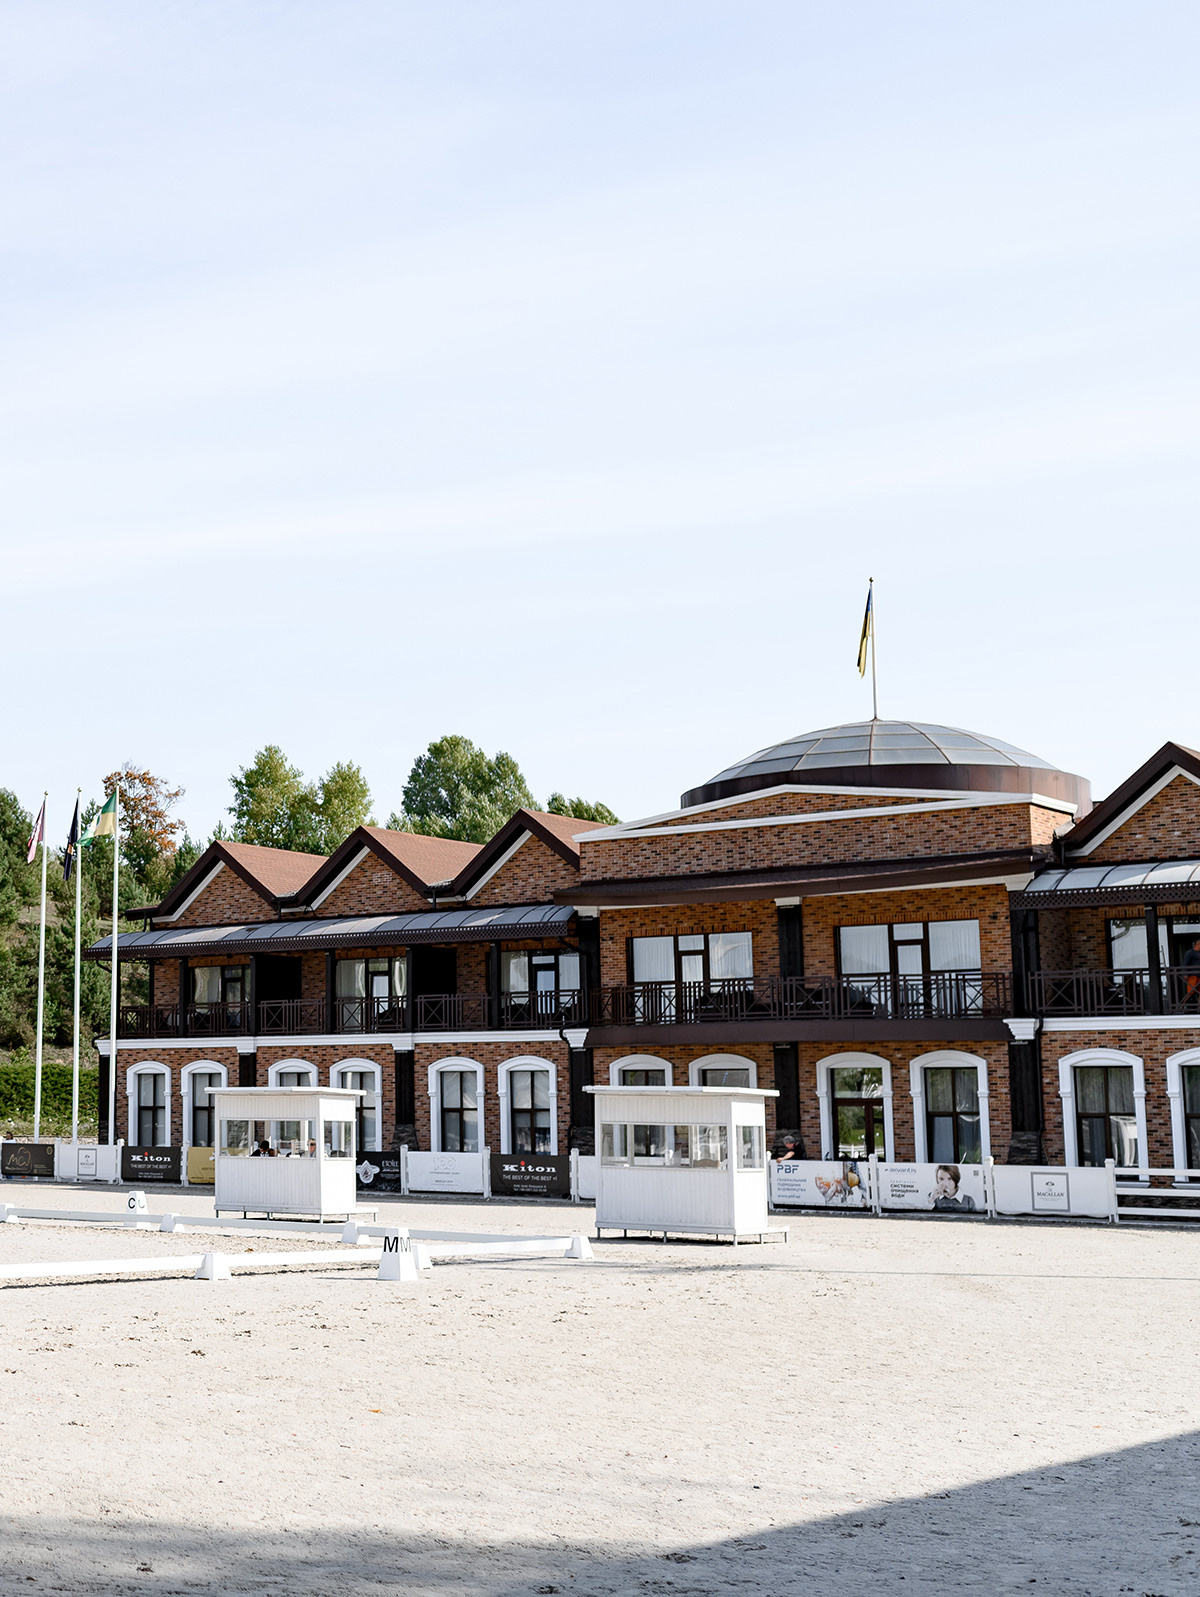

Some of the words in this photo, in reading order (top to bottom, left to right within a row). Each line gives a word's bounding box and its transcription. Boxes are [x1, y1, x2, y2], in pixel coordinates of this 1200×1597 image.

[131, 1151, 172, 1162] Kiton
[502, 1160, 557, 1173] Kiton
[776, 1164, 799, 1174] PBF
[128, 1197, 136, 1209] C
[383, 1236, 399, 1253] M
[400, 1237, 412, 1253] M
